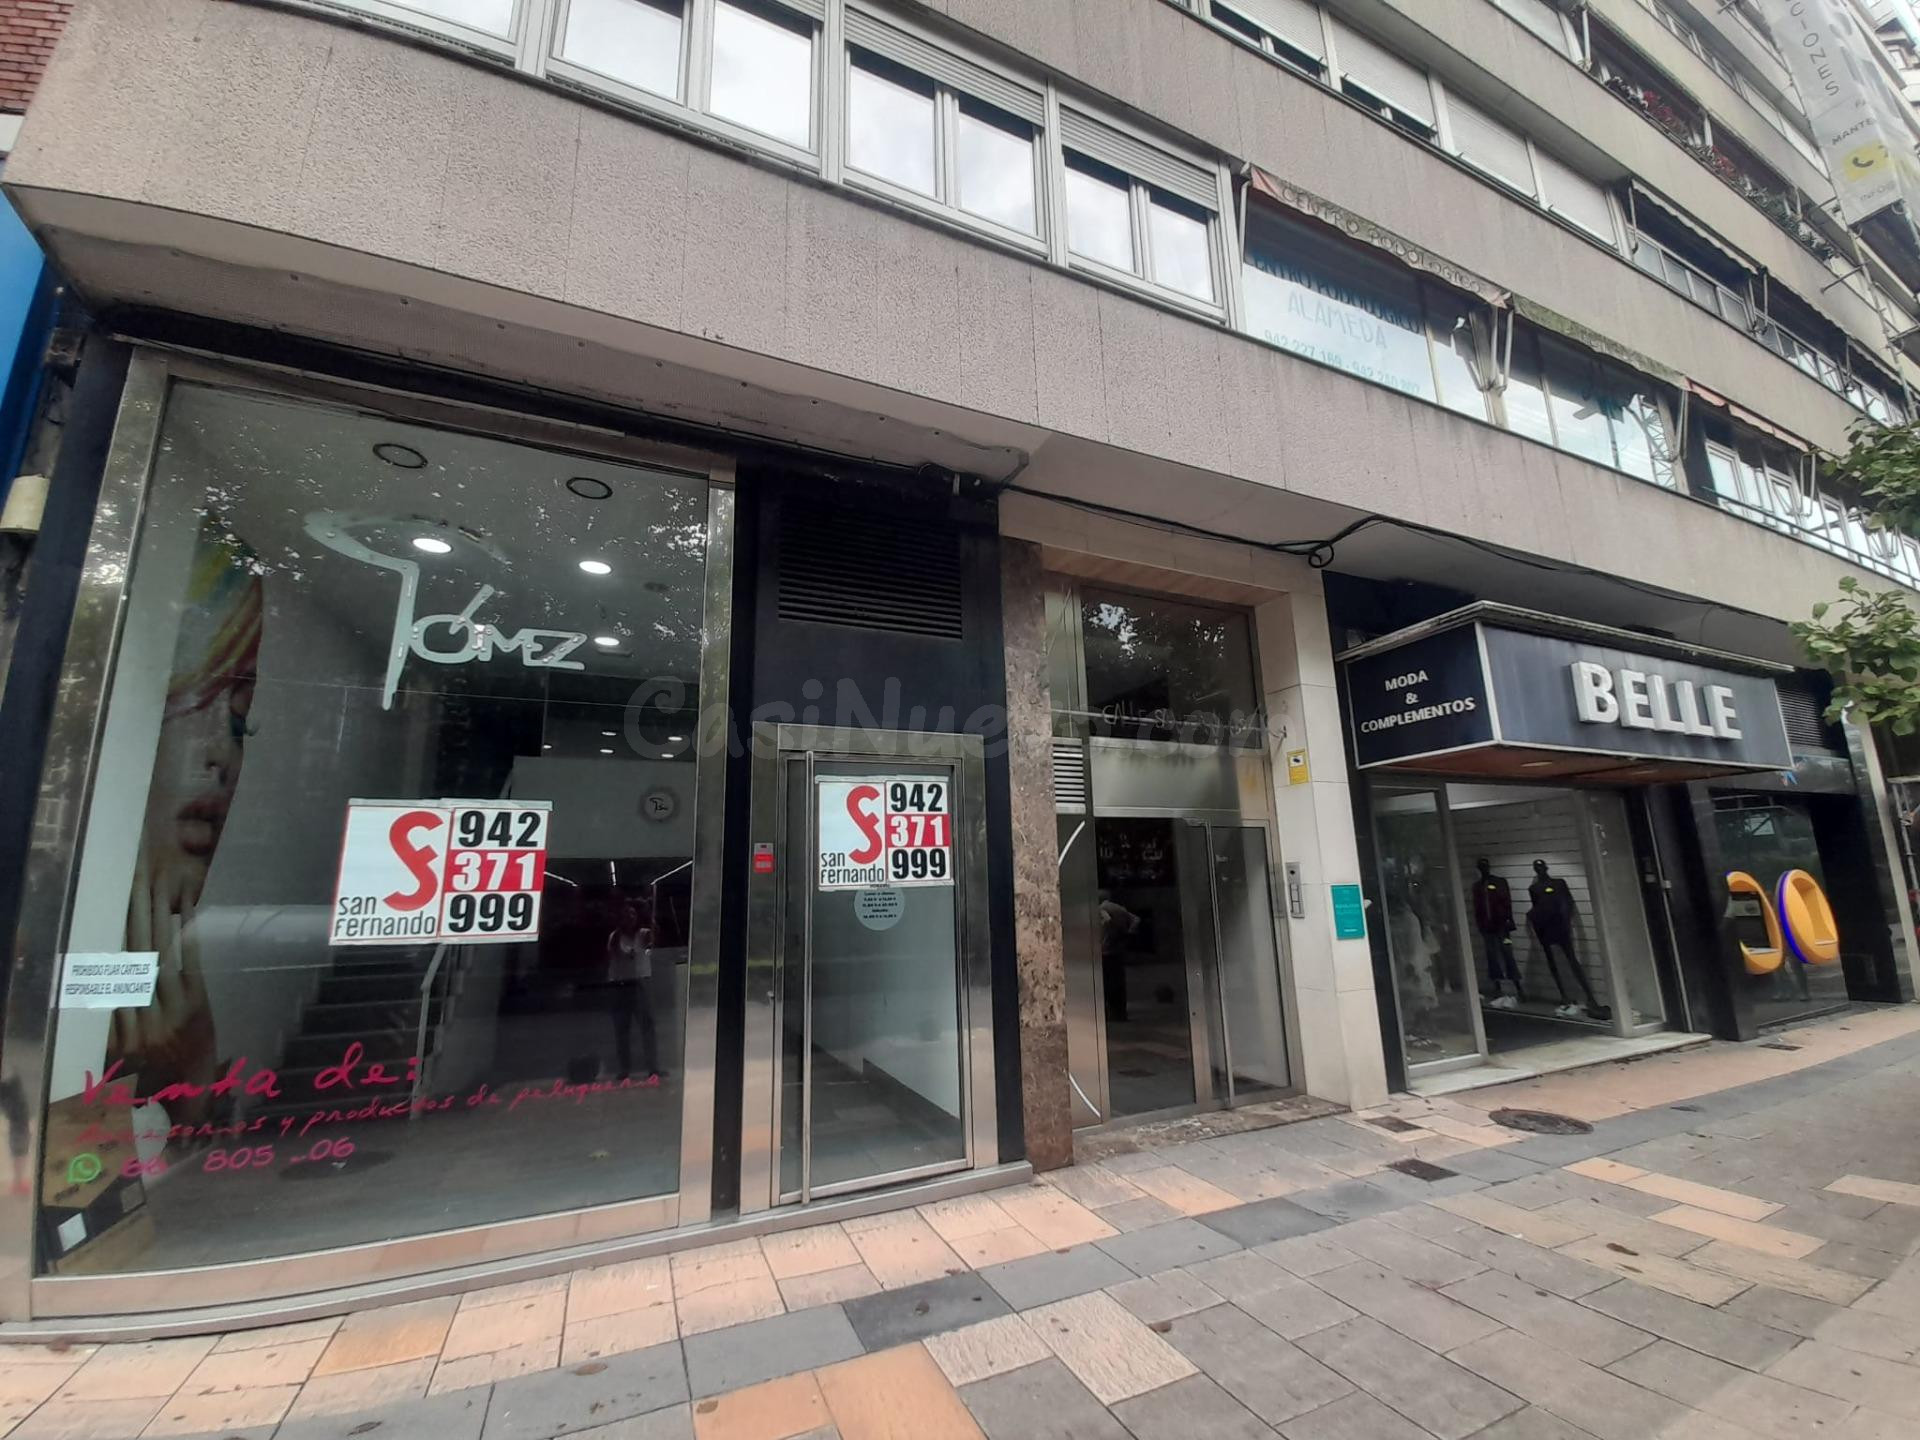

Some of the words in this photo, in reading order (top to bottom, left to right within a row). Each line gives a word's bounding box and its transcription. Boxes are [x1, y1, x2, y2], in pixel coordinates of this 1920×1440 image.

[1785, 0, 1839, 97] CIONES
[1288, 290, 1388, 350] ALAMEDA
[1385, 670, 1429, 691] MODA
[1405, 692, 1419, 705] &
[1571, 661, 1742, 740] BELLE
[1361, 697, 1476, 733] COMPLEMENTOS
[890, 783, 943, 812] 942
[458, 811, 541, 848] 942
[890, 815, 944, 846] 371
[452, 851, 536, 891] 371
[820, 864, 885, 884] fernando
[821, 852, 846, 867] san
[892, 848, 946, 879] 999
[338, 896, 377, 915] san
[448, 893, 534, 933] 999
[334, 910, 436, 937] fernando
[83, 1058, 281, 1104] Venta
[203, 1145, 275, 1172] 805
